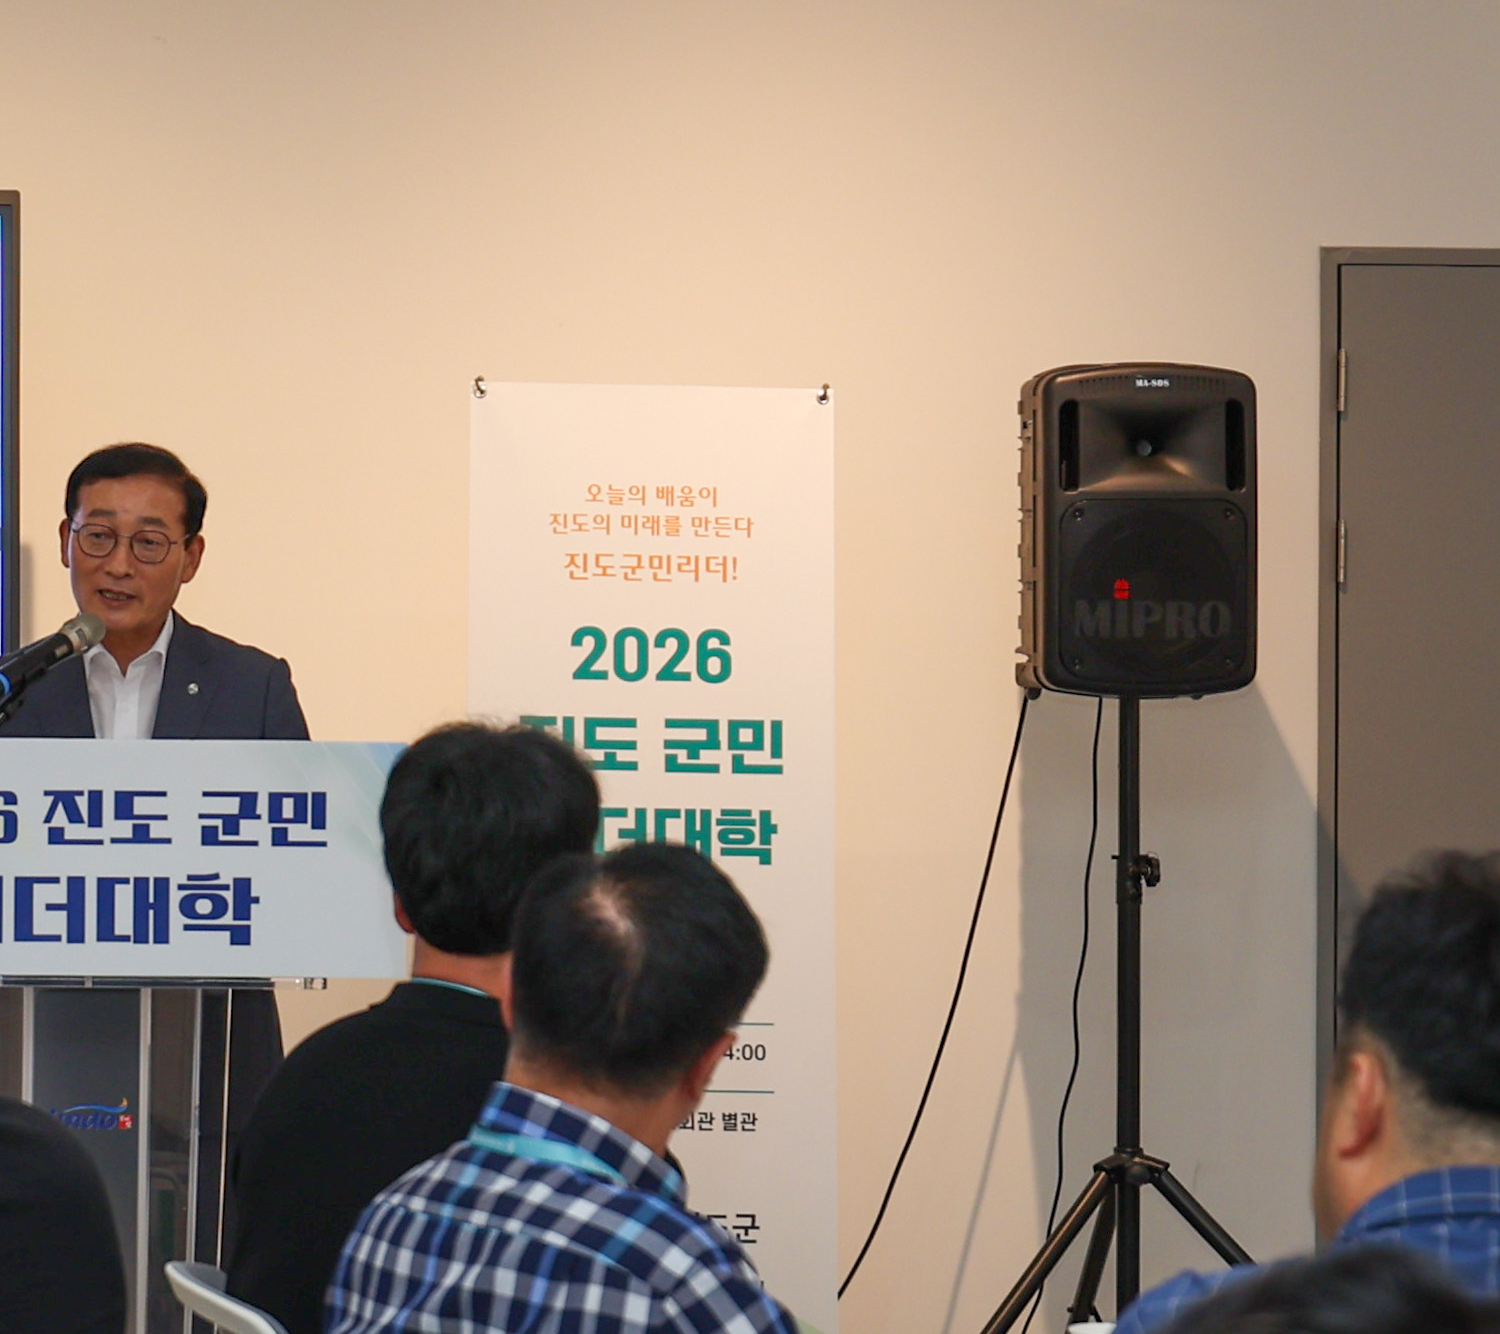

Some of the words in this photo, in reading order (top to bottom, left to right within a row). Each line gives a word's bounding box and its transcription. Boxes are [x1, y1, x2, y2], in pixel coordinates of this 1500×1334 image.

[584, 483, 647, 506] 오늘의
[655, 484, 719, 508] 배움이
[548, 512, 611, 536] 진도의
[620, 513, 683, 537] 미래를
[690, 515, 755, 539] 만든다
[563, 552, 738, 583] 진도군민리더!
[570, 625, 733, 684] 2026
[663, 717, 784, 775] 군민
[42, 789, 174, 846] 진도
[197, 790, 328, 848] 군민
[720, 1111, 759, 1132] 별관
